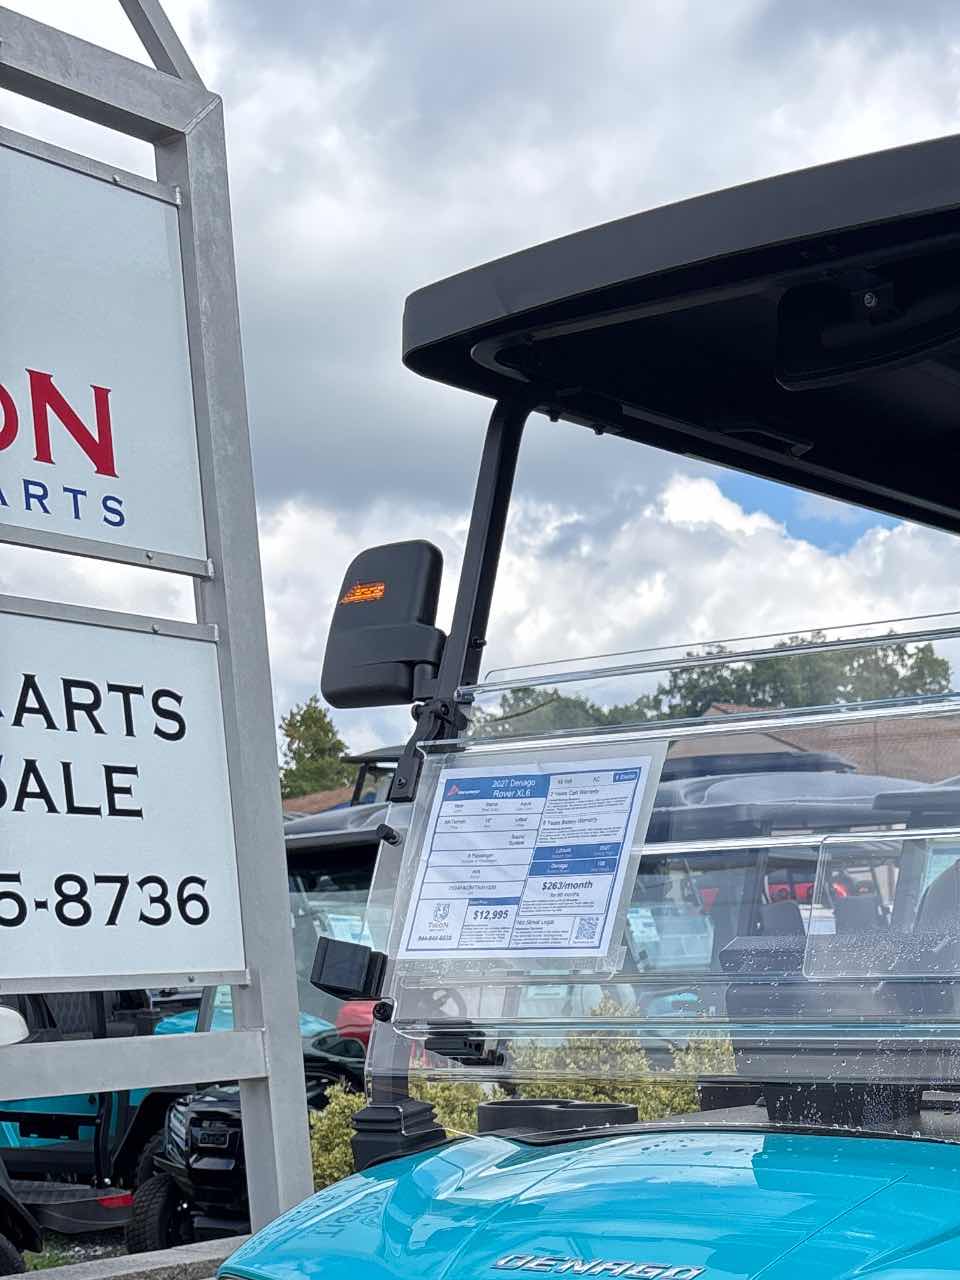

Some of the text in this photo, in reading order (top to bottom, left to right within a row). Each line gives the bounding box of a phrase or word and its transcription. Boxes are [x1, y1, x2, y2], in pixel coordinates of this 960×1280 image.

[0, 672, 187, 742] ARTS
[0, 754, 144, 820] ALE
[492, 789, 515, 798] Rover
[0, 871, 210, 927] 5-8736
[541, 879, 593, 891] $263/month
[472, 910, 509, 920] $12,995
